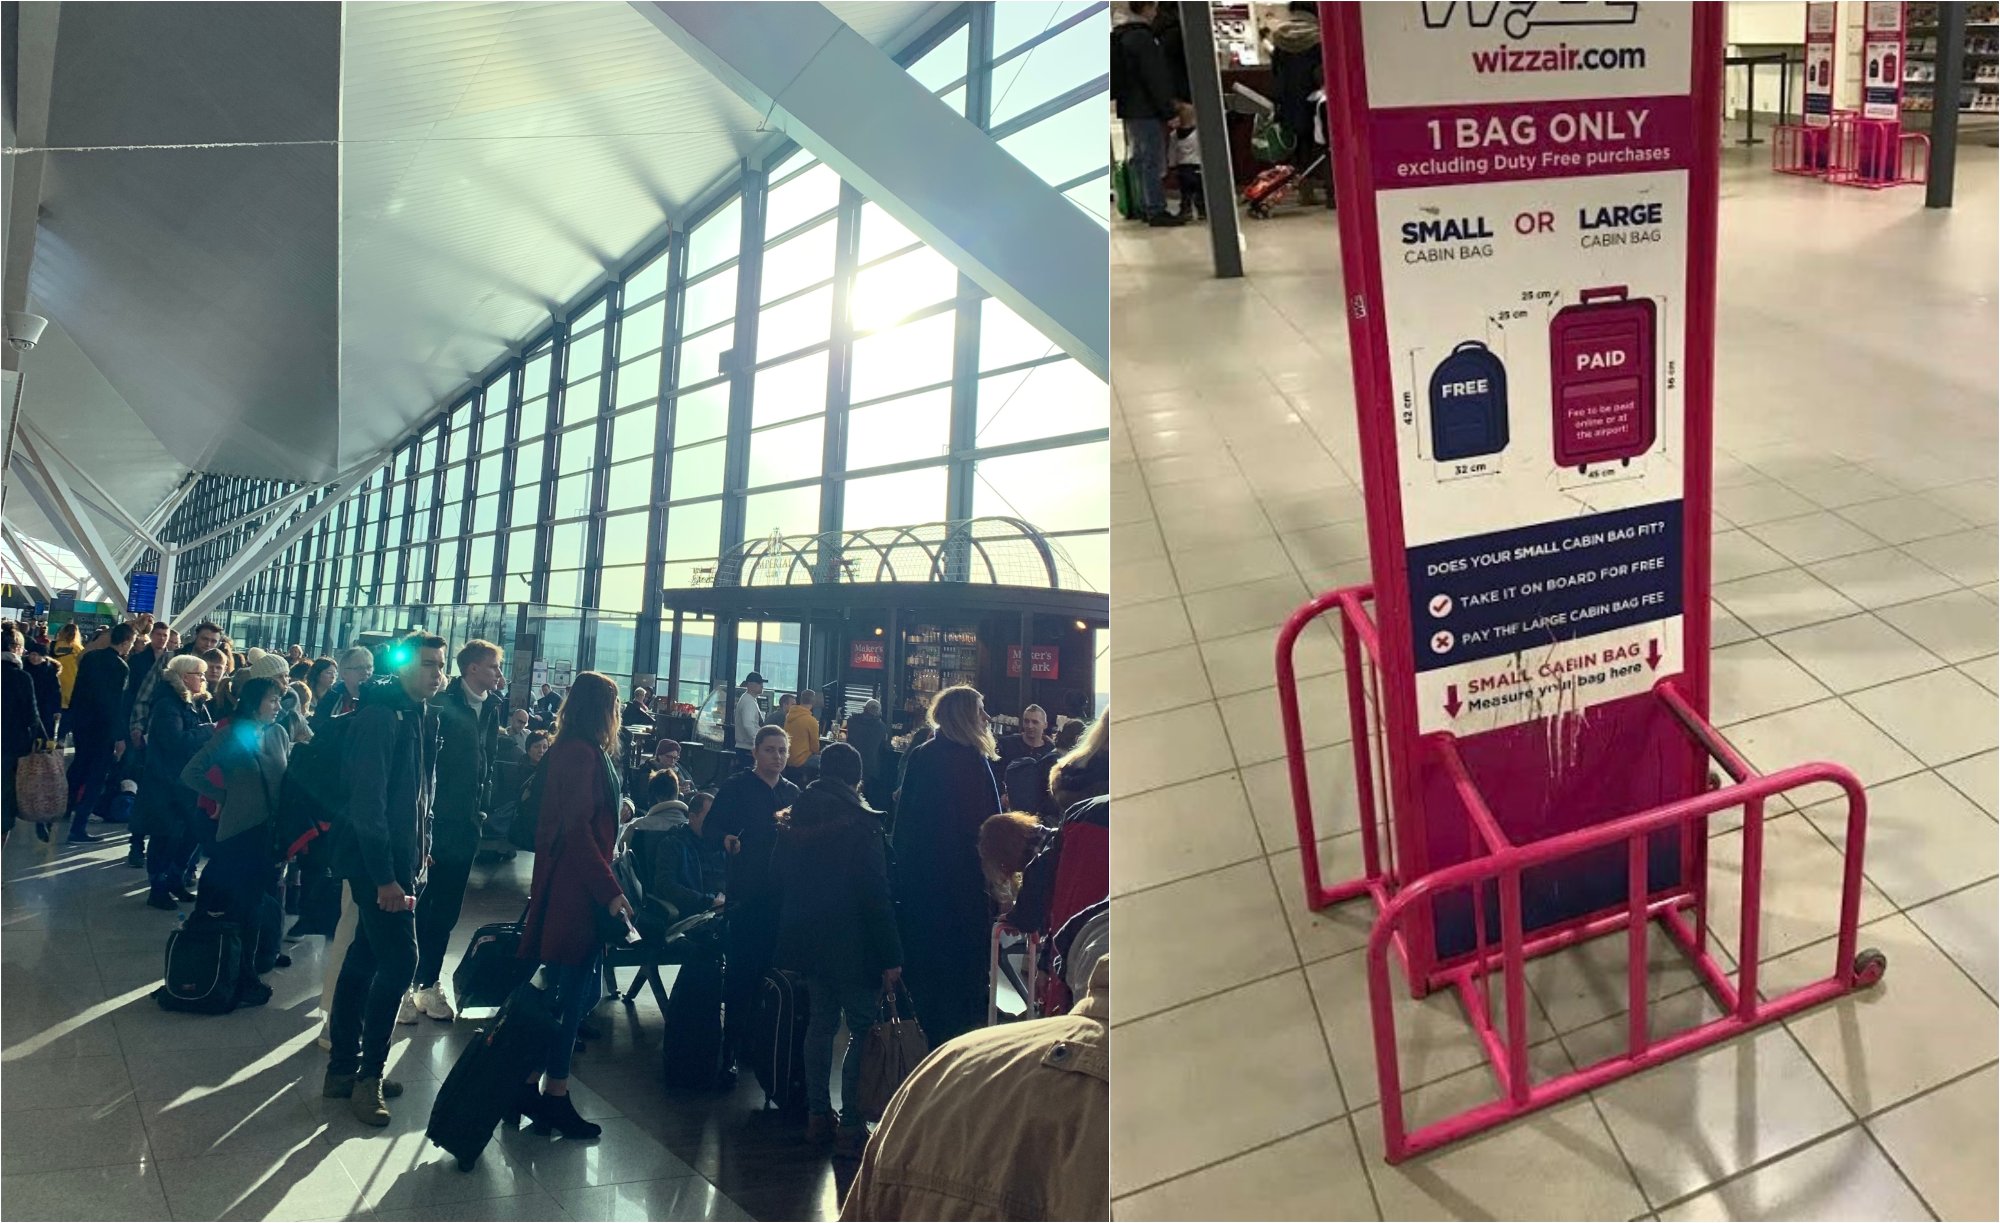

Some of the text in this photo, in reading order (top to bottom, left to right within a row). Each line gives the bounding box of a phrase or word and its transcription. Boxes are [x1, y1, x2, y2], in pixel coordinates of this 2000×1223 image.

[1472, 43, 1646, 73] wizzair.com
[1427, 109, 1650, 150] 1 BAG ONLY
[1397, 146, 1671, 177] excluding Duty Free purchases
[1402, 203, 1662, 245] SMALL OR LARGE
[1580, 229, 1662, 249] CABIN BAG
[1404, 243, 1494, 264] CABIN BAG
[1521, 289, 1551, 301] 25 cm
[1498, 309, 1528, 320] 25 cm
[1576, 350, 1626, 371] PAID
[1441, 378, 1490, 399] FREE
[1403, 391, 1414, 426] 42 cm
[1568, 401, 1635, 418] Fee to be paid
[1574, 413, 1628, 428] online or at
[1576, 429, 1592, 440] the
[1455, 463, 1487, 475] 32 cm
[1602, 468, 1615, 477] cm
[1427, 521, 1665, 577] DOES YOUR SMALL CABIN BAG FIT?
[1460, 556, 1665, 608] TAKE IT ON BOARD FOR FREE
[1461, 629, 1490, 646] PAY
[1570, 603, 1610, 623] CABIN
[1612, 597, 1639, 614] BAG
[1642, 591, 1666, 606] FEE
[854, 643, 884, 653] Maker's
[862, 653, 883, 663] Mark
[1012, 649, 1052, 660] Mer's
[1031, 662, 1051, 672] ark
[1467, 643, 1641, 695] SMALL CABIN BAG
[1467, 688, 1535, 713] Measure
[1577, 669, 1606, 689] bag
[1609, 662, 1643, 679] here
